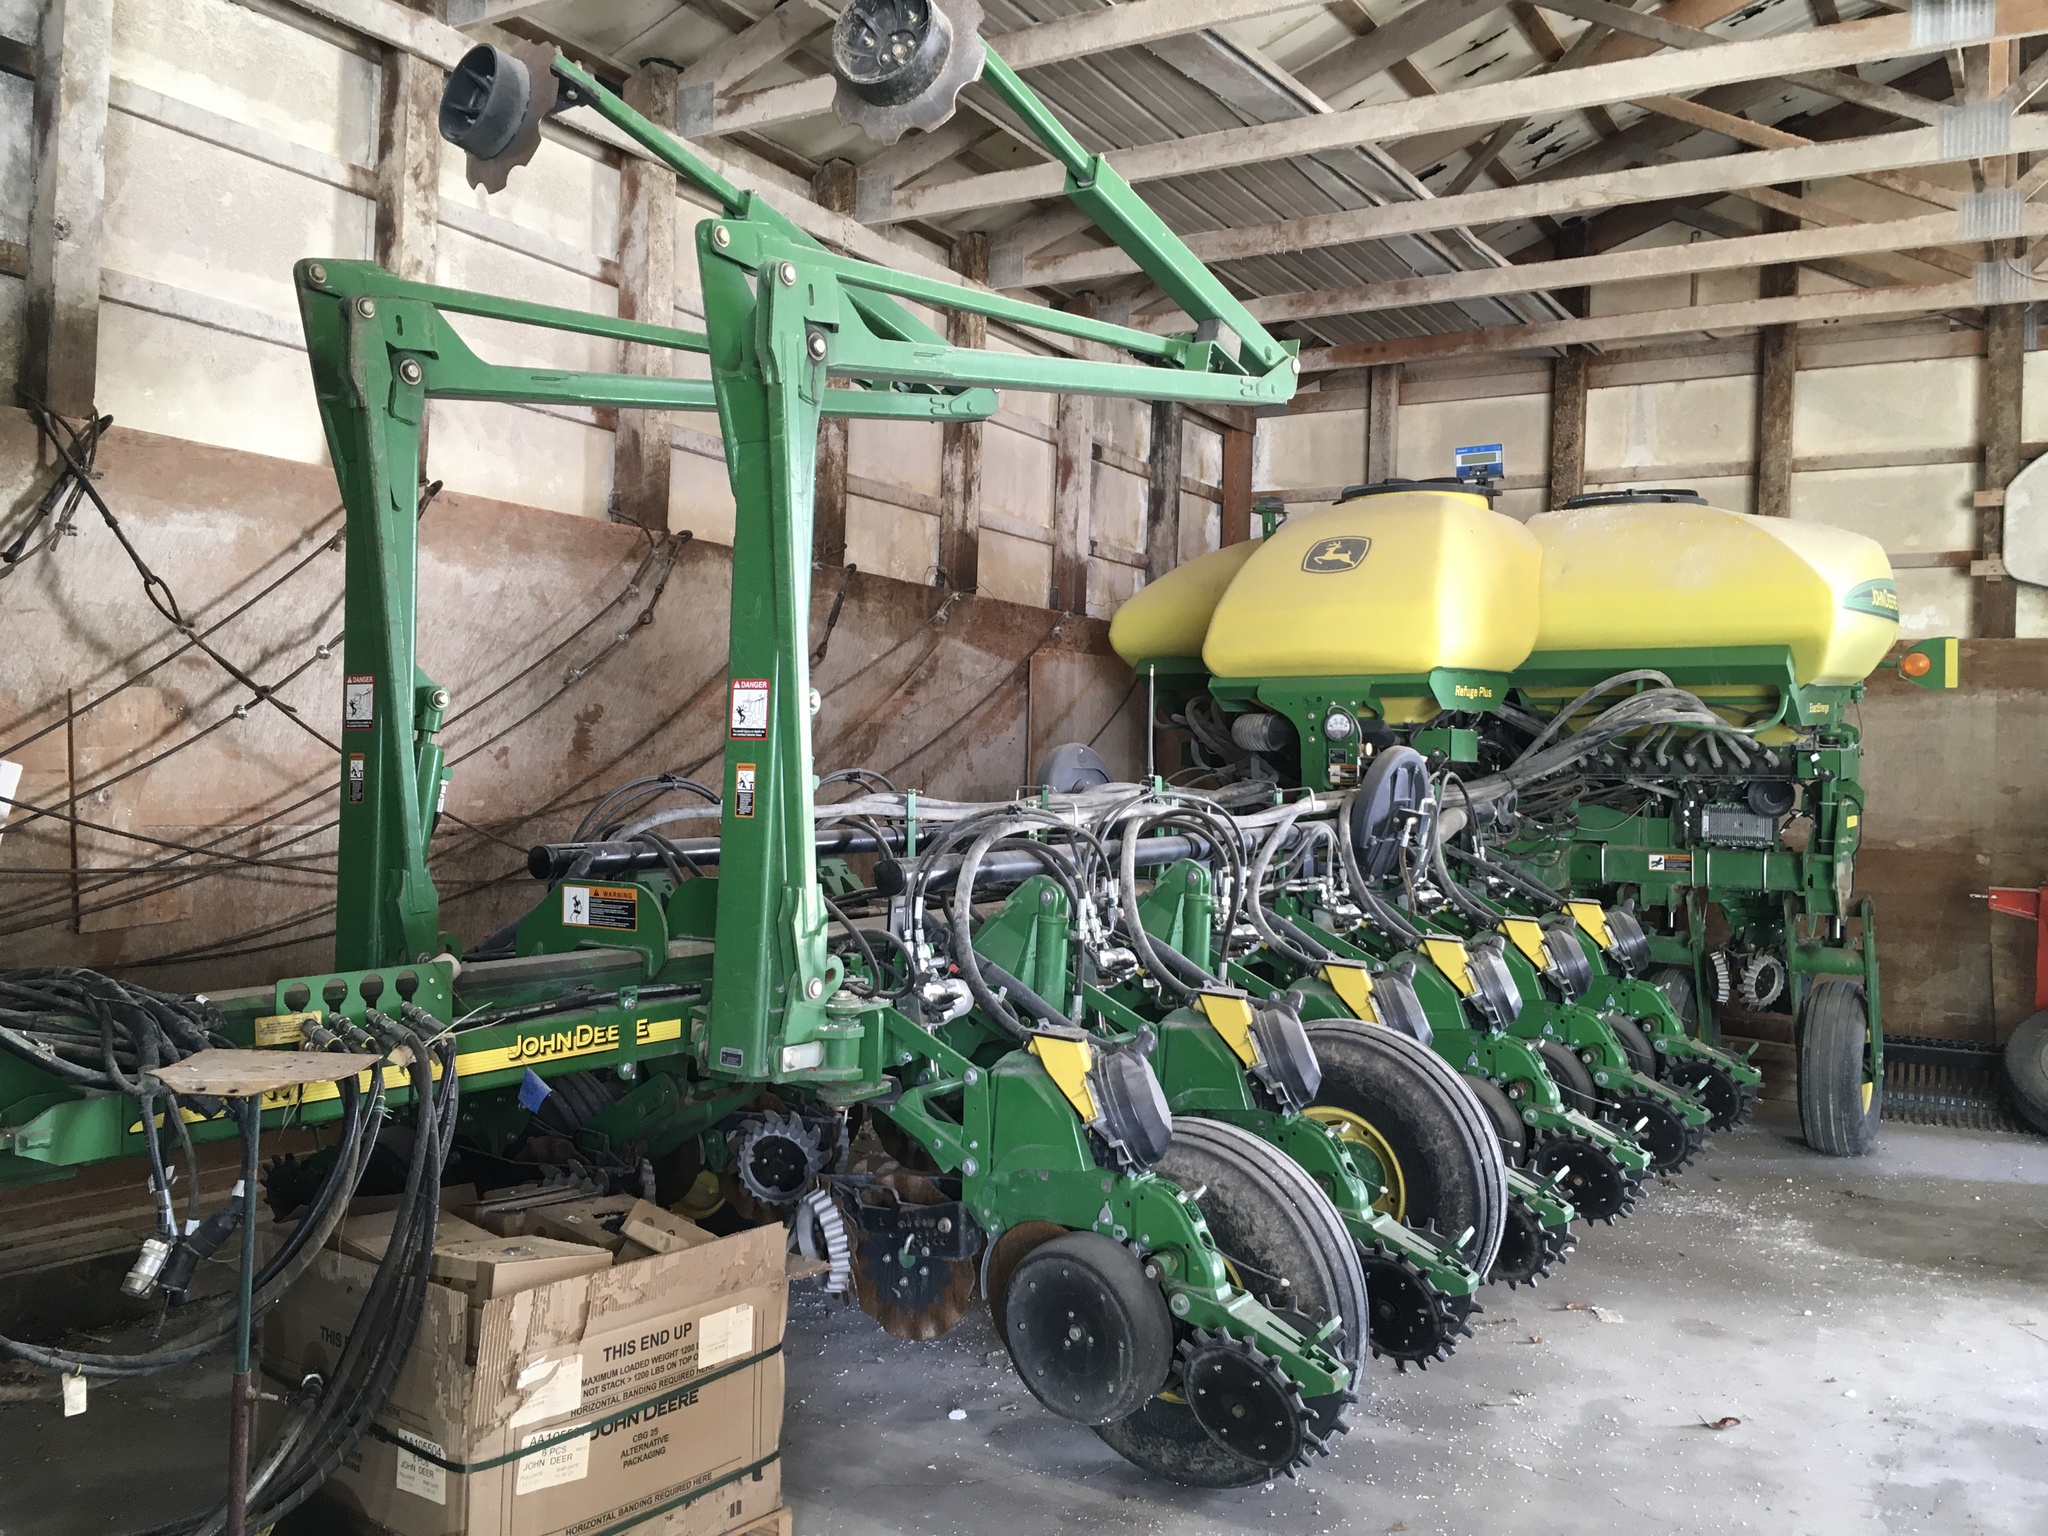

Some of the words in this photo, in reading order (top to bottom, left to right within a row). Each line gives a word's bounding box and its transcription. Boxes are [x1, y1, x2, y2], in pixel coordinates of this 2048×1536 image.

[740, 681, 768, 689] DANGER
[1454, 684, 1478, 700] Refuge
[1478, 685, 1493, 698] Plus
[602, 891, 633, 899] WARNING
[508, 1029, 573, 1061] JOHN
[575, 1018, 650, 1049] DEEE
[320, 1325, 343, 1348] THIS
[603, 1339, 637, 1363] THIS
[640, 1329, 670, 1352] END
[674, 1321, 693, 1341] UP
[581, 1368, 619, 1388] MAXIMUM
[619, 1358, 650, 1375] LOADED
[651, 1349, 680, 1365] WEIGHT
[680, 1343, 695, 1355] 1200
[582, 1386, 600, 1399] NOT
[601, 1377, 626, 1393] STACK
[633, 1369, 650, 1382] 1200
[650, 1364, 665, 1376] LBS
[666, 1360, 678, 1371] ON
[678, 1355, 693, 1368] TOP
[570, 1397, 621, 1418] HORIZONTAL
[622, 1381, 657, 1401] BANDING
[658, 1369, 695, 1388] REQUIRED
[696, 1364, 715, 1375] HERE
[590, 1411, 641, 1442] JOHN
[643, 1388, 700, 1422] DEERE
[620, 1433, 670, 1460] ALTERNATIVE
[632, 1429, 649, 1443] CBG
[650, 1426, 659, 1437] 25
[523, 1459, 546, 1472] JOHN
[549, 1453, 574, 1466] DEER
[549, 1445, 568, 1456] PCS
[622, 1445, 667, 1469] PACKAGING
[400, 1460, 416, 1473] JOHN
[418, 1465, 435, 1479] DEER
[565, 1511, 617, 1536] HORIZONTAL
[618, 1496, 653, 1517] BANDING
[654, 1480, 692, 1503] REQUIRED
[693, 1471, 713, 1487] HERE
